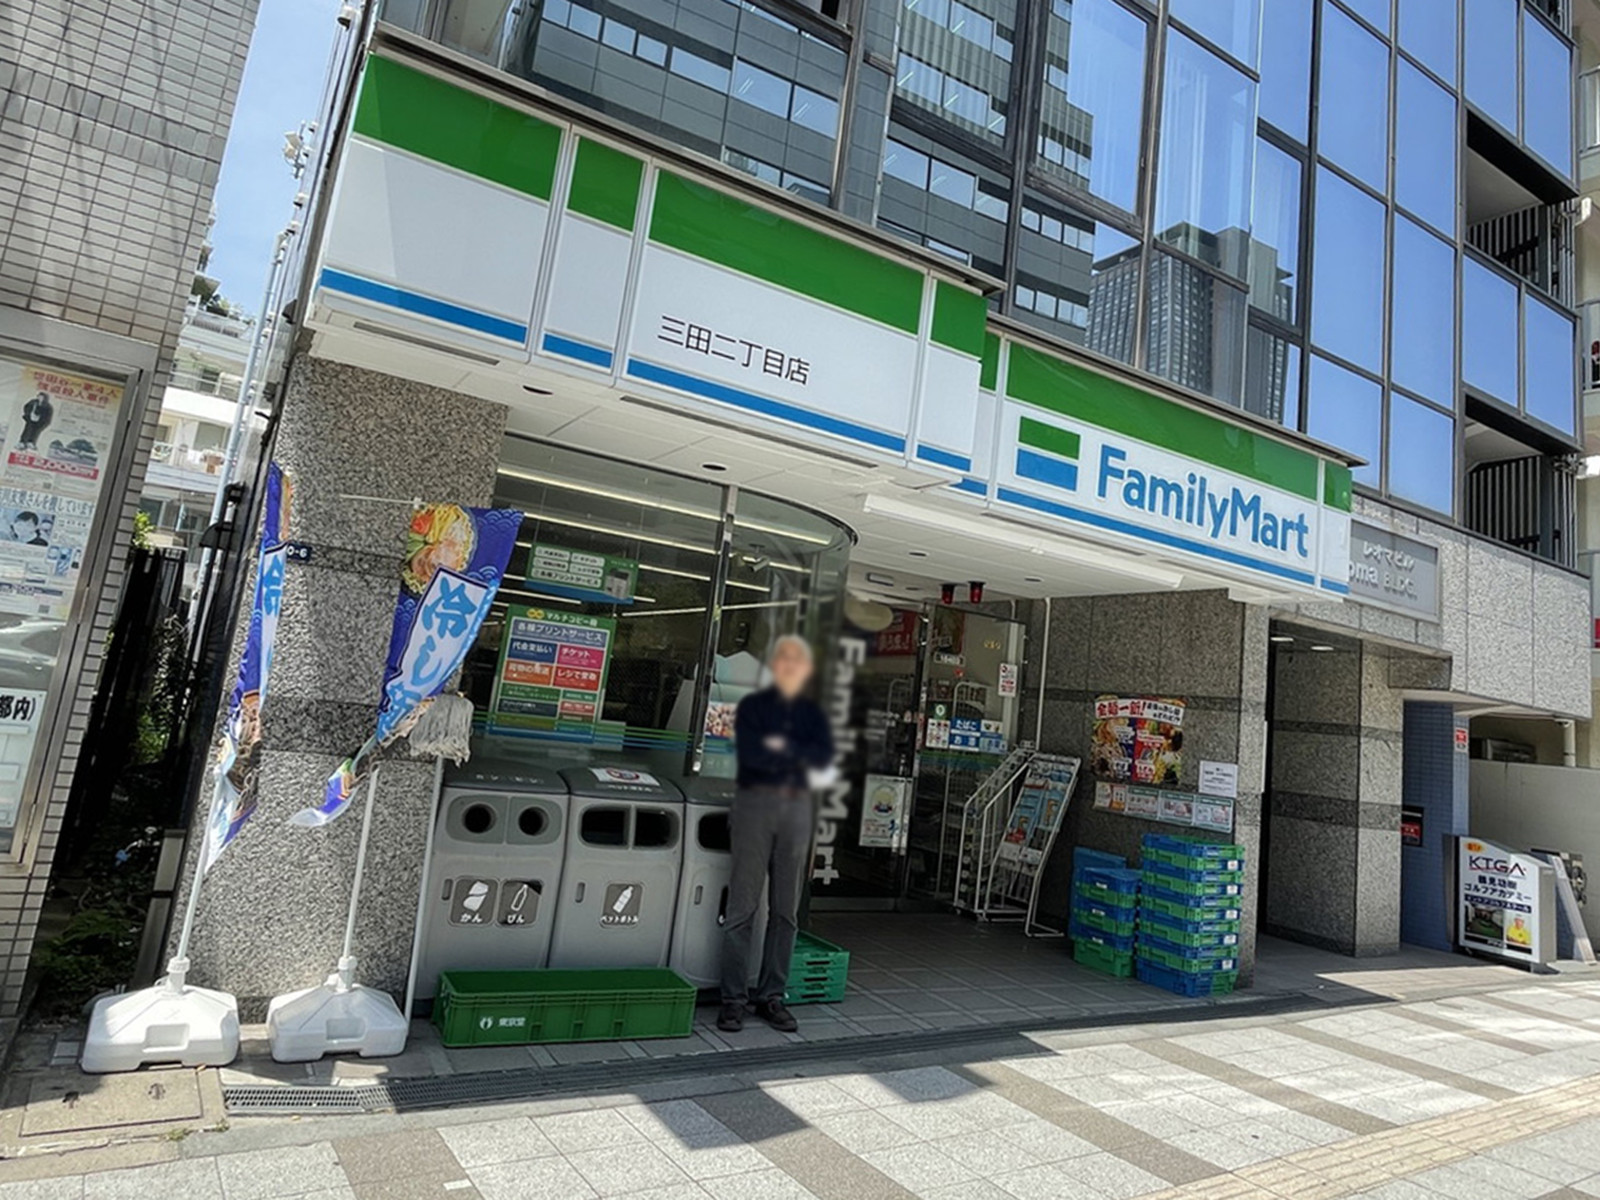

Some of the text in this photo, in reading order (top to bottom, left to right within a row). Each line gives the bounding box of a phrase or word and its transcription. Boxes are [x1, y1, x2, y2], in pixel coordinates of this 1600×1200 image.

[657, 315, 810, 385] 三田二丁目店
[1097, 443, 1309, 557] FamilyMart
[518, 622, 604, 641] 各種プリントサービス
[561, 647, 591, 658] チケット
[956, 719, 978, 731] たばこ
[1469, 855, 1525, 876] KTGA
[1464, 883, 1532, 902] ゴルフアカデミー
[460, 913, 483, 924] かん
[506, 913, 525, 924] びん
[600, 914, 640, 923] ペットボトル
